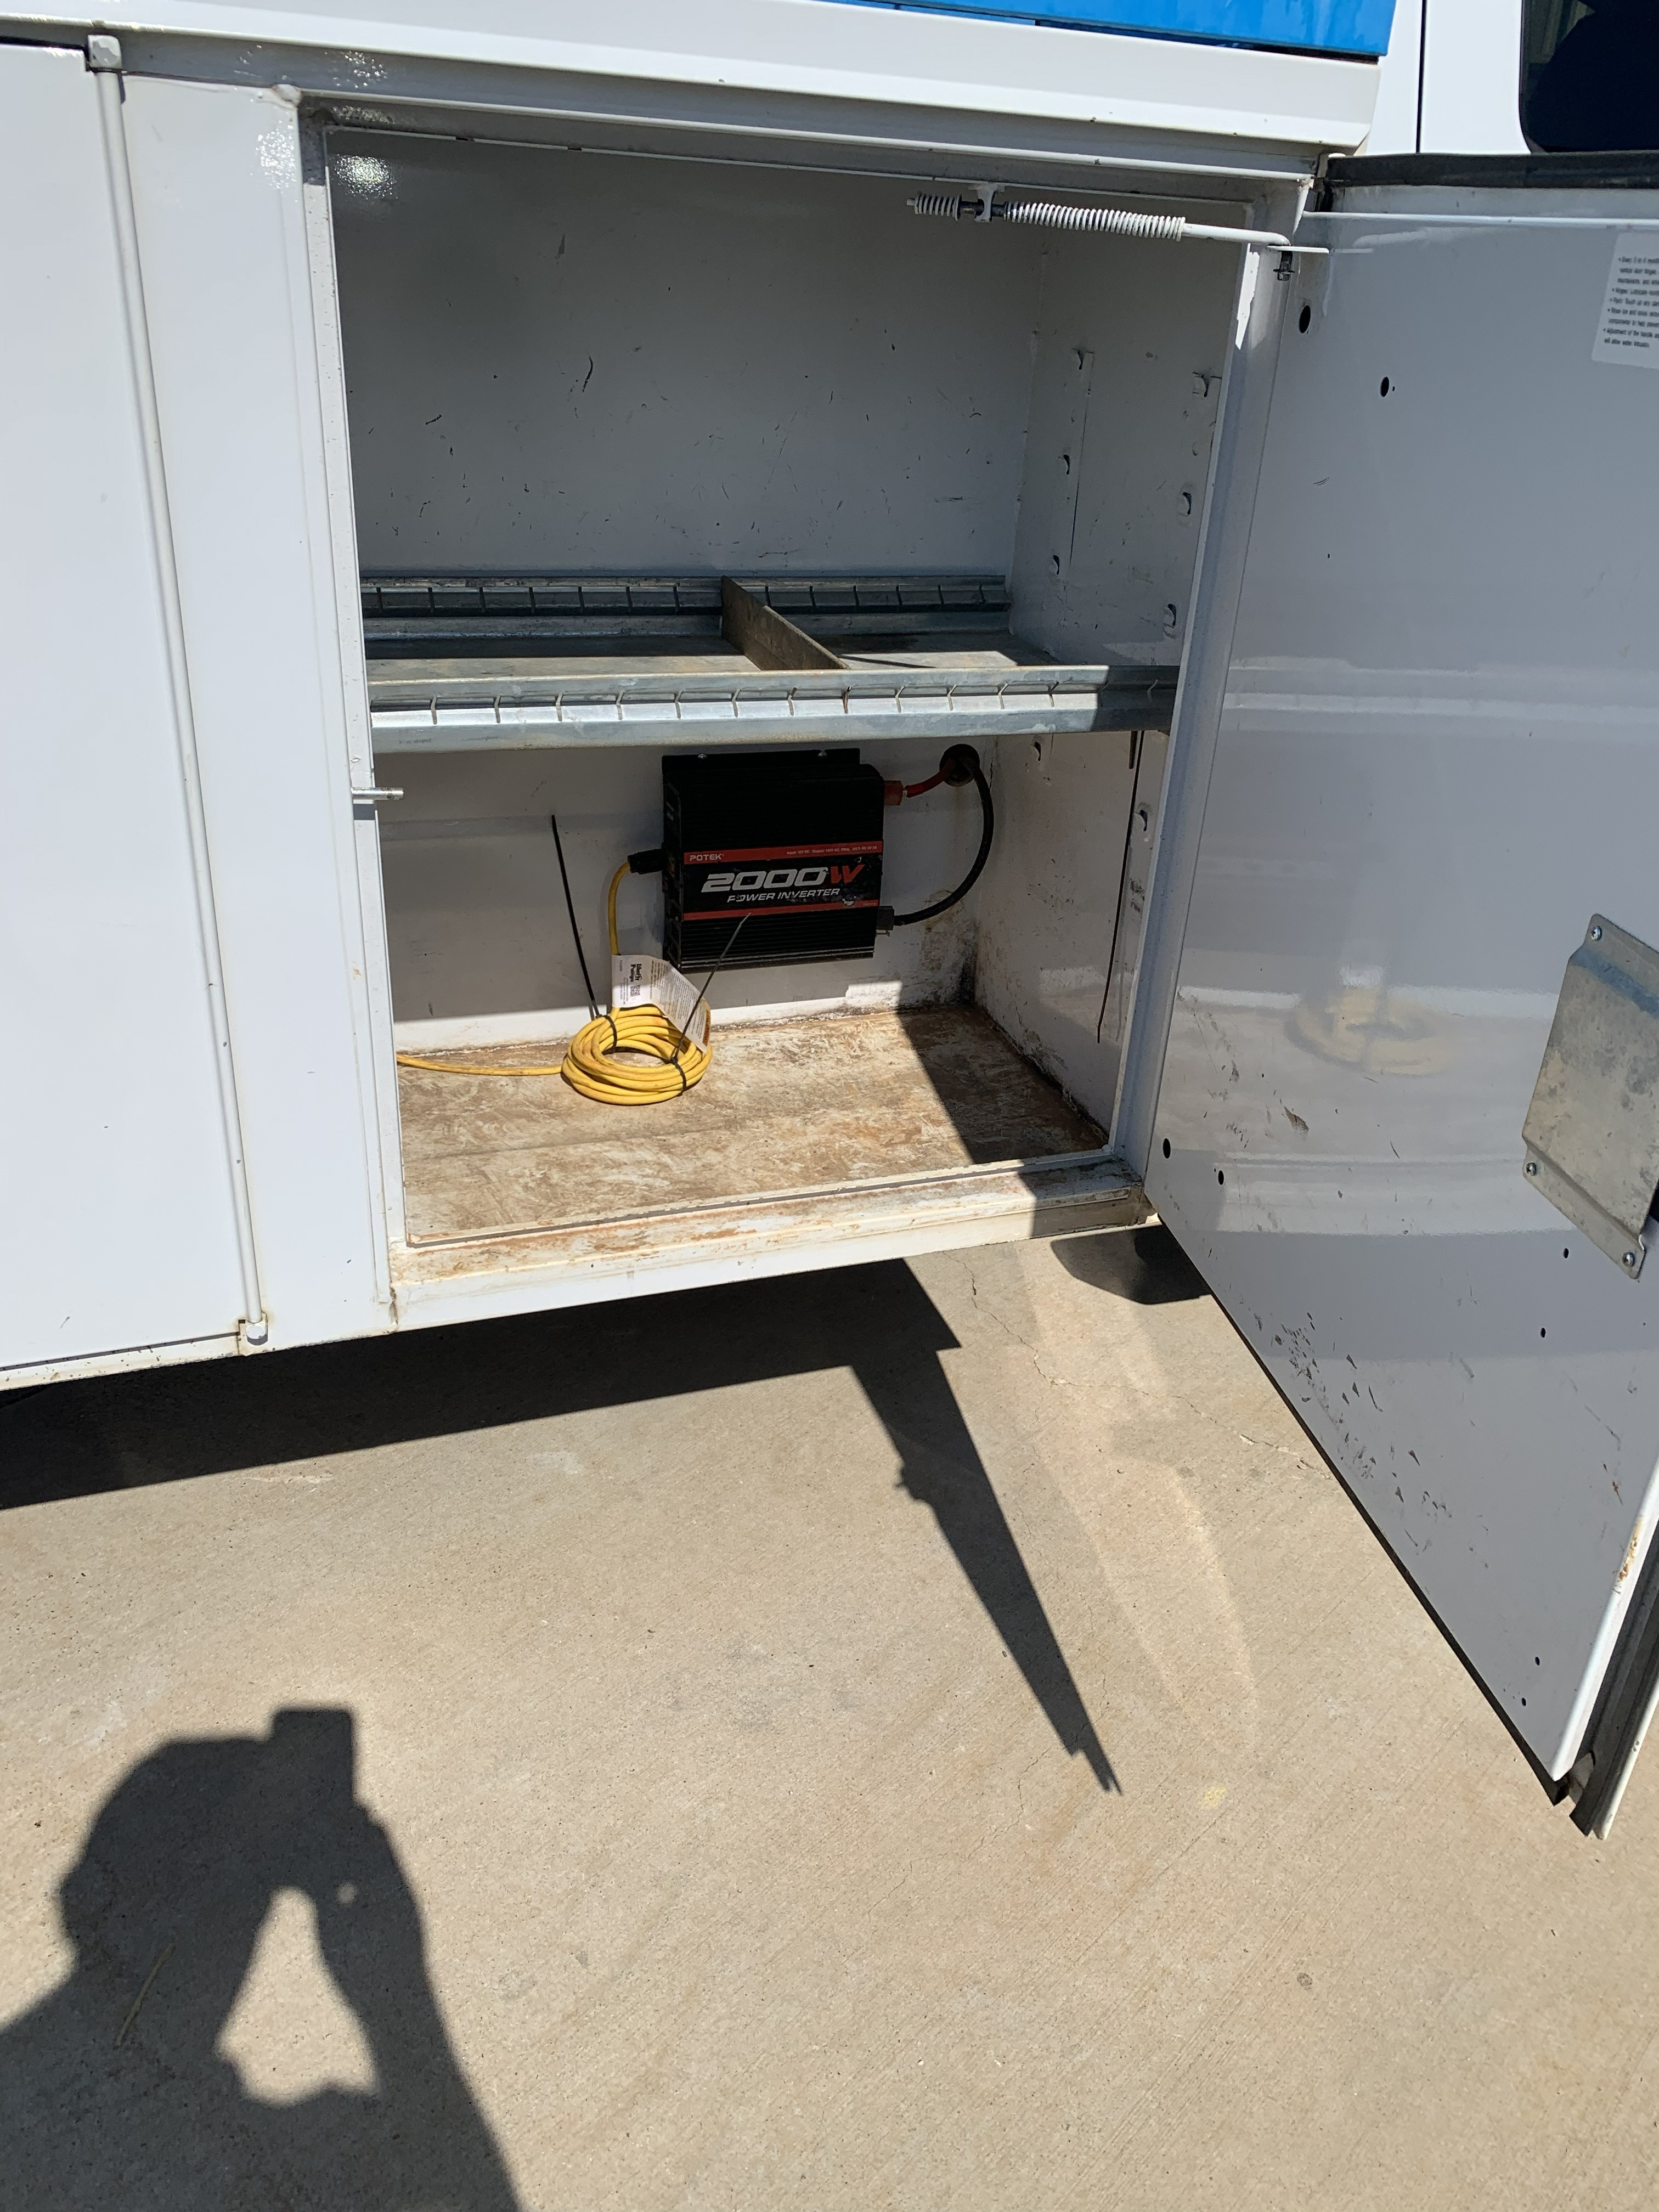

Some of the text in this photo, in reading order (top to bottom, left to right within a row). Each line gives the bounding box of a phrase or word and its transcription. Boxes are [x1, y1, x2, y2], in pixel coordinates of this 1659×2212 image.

[689, 853, 721, 861] POTEK
[701, 864, 865, 893] 2000W
[727, 888, 840, 902] POWER INVERTER
[634, 963, 642, 981] Liberty
